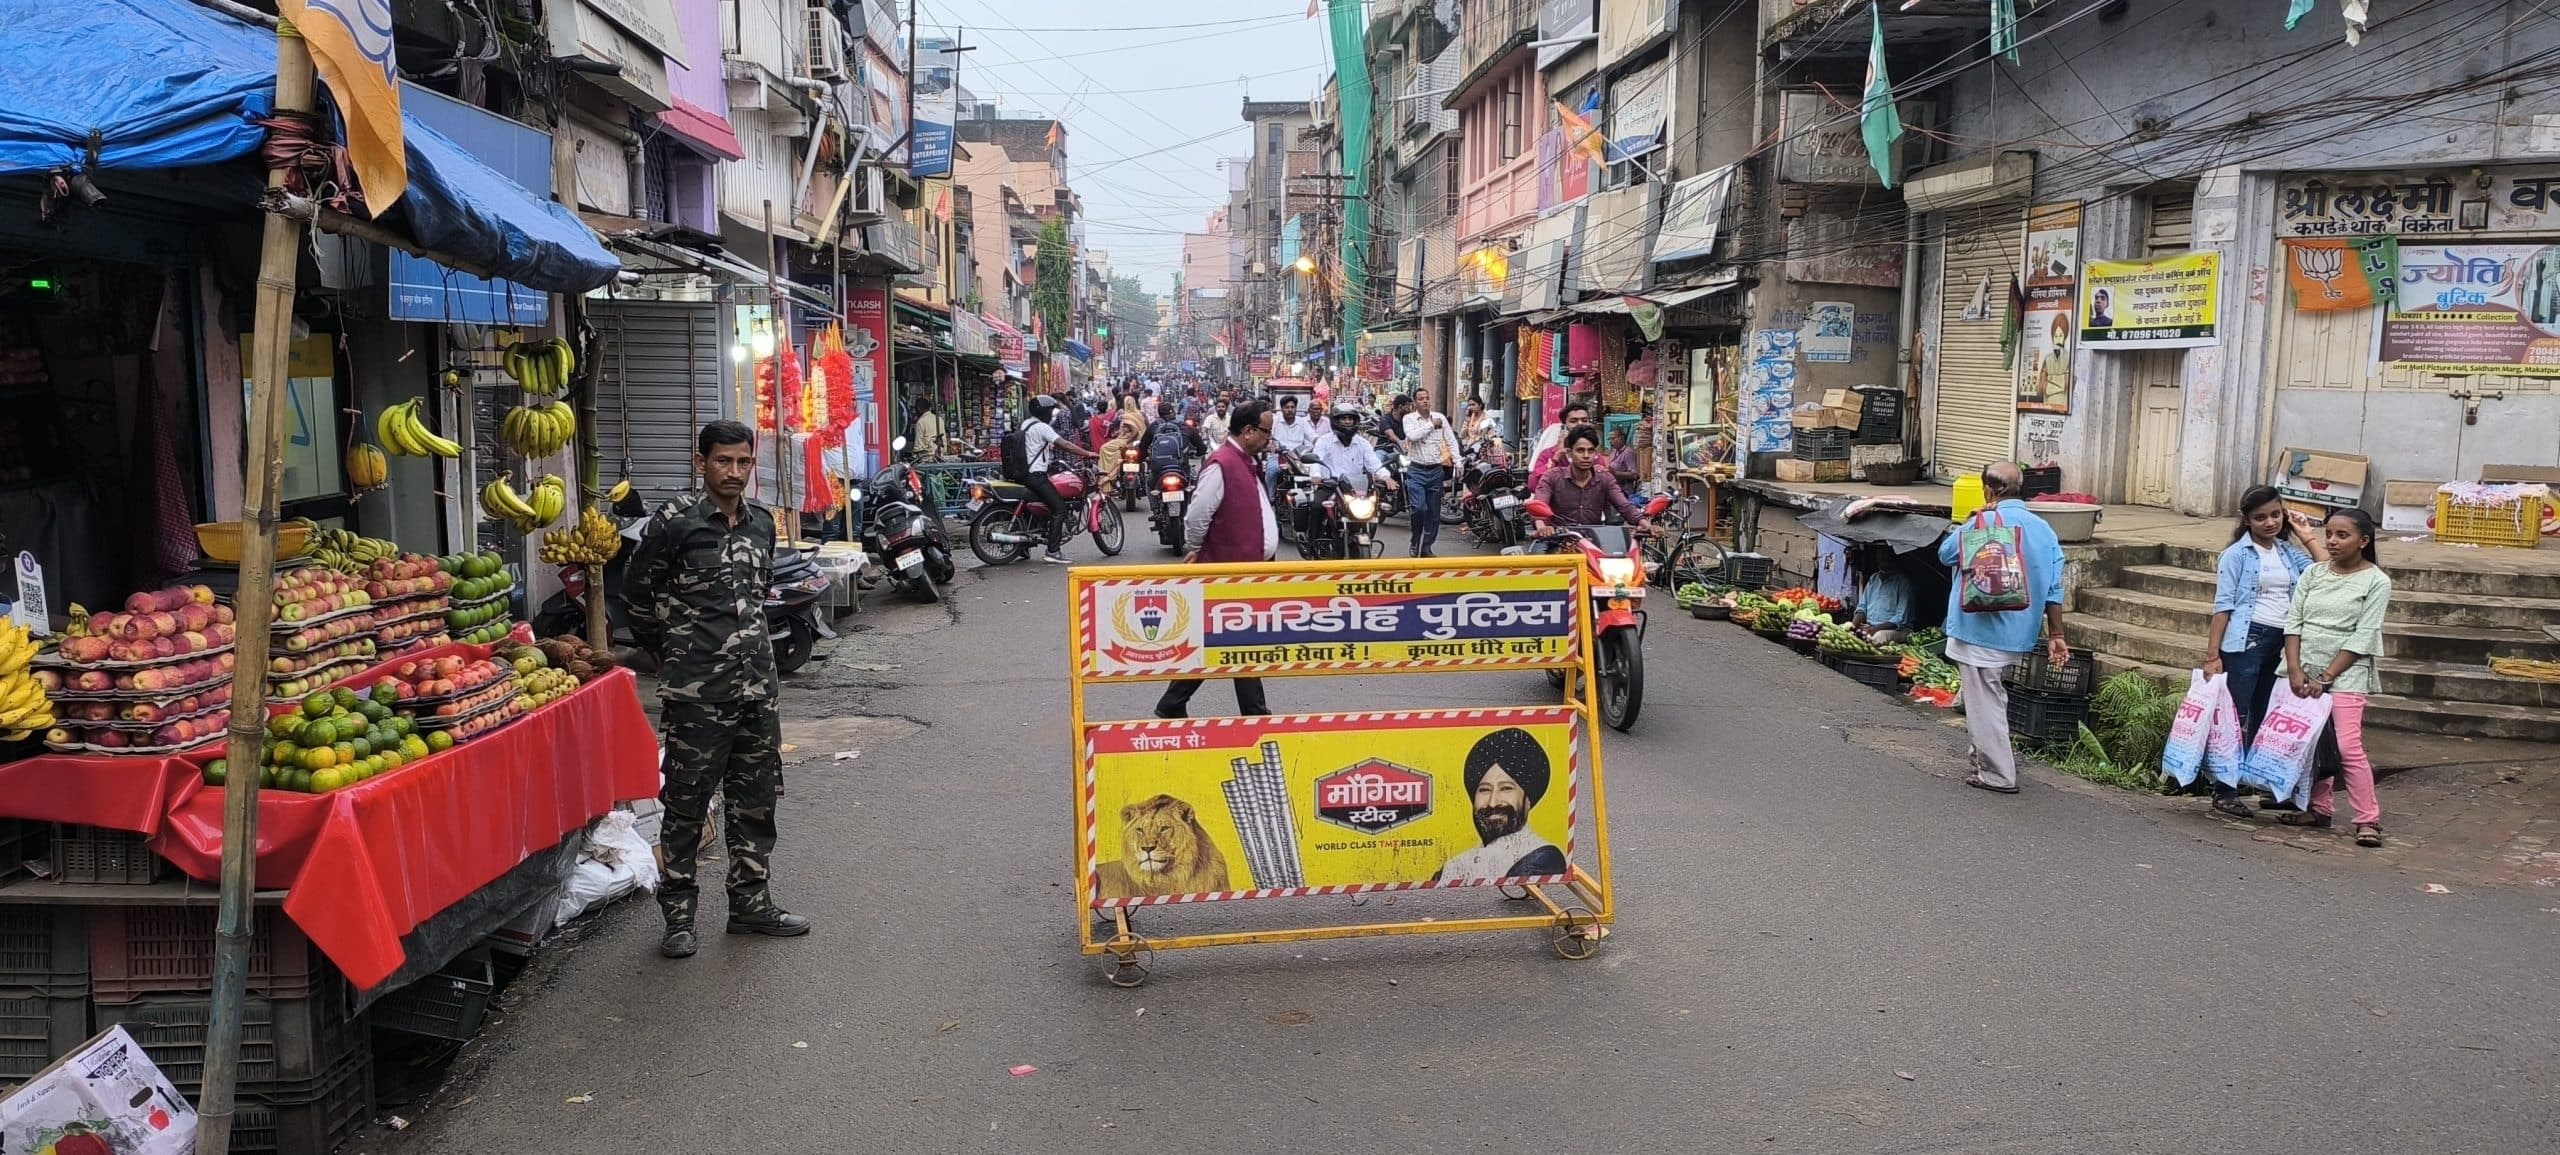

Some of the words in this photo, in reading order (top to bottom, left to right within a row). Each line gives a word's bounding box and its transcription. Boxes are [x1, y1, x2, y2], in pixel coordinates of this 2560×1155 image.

[912, 149, 948, 160] ENTERPRISES
[2283, 178, 2329, 219] श्री
[2333, 176, 2456, 222] लक्ष्मी
[2510, 177, 2560, 214] व
[2351, 216, 2387, 234] थोक
[2401, 214, 2454, 233] विक्रेता
[2402, 248, 2504, 284] ज्योति
[2436, 287, 2487, 310] बुटिक
[2121, 328, 2181, 340] 8709614020
[2426, 363, 2451, 371] Picture
[1337, 580, 1413, 595] समर्पित
[1208, 597, 1404, 635] गिरिडीह
[1417, 592, 1566, 640] पुलिस
[1219, 646, 1291, 665] आपकी
[1295, 643, 1333, 662] सेवा
[1340, 643, 1358, 661] में
[1408, 642, 1466, 662] कृपया
[1471, 639, 1504, 656] धीरे
[1511, 637, 1545, 655] चलें
[1131, 732, 1182, 750] सौजन्य
[1326, 773, 1424, 805] मोंगिया
[1349, 806, 1399, 823] स्टील
[1315, 842, 1347, 851] WORLD
[1350, 840, 1377, 850] CLASS
[1379, 839, 1400, 849] TMT
[1401, 838, 1434, 847] REBARS
